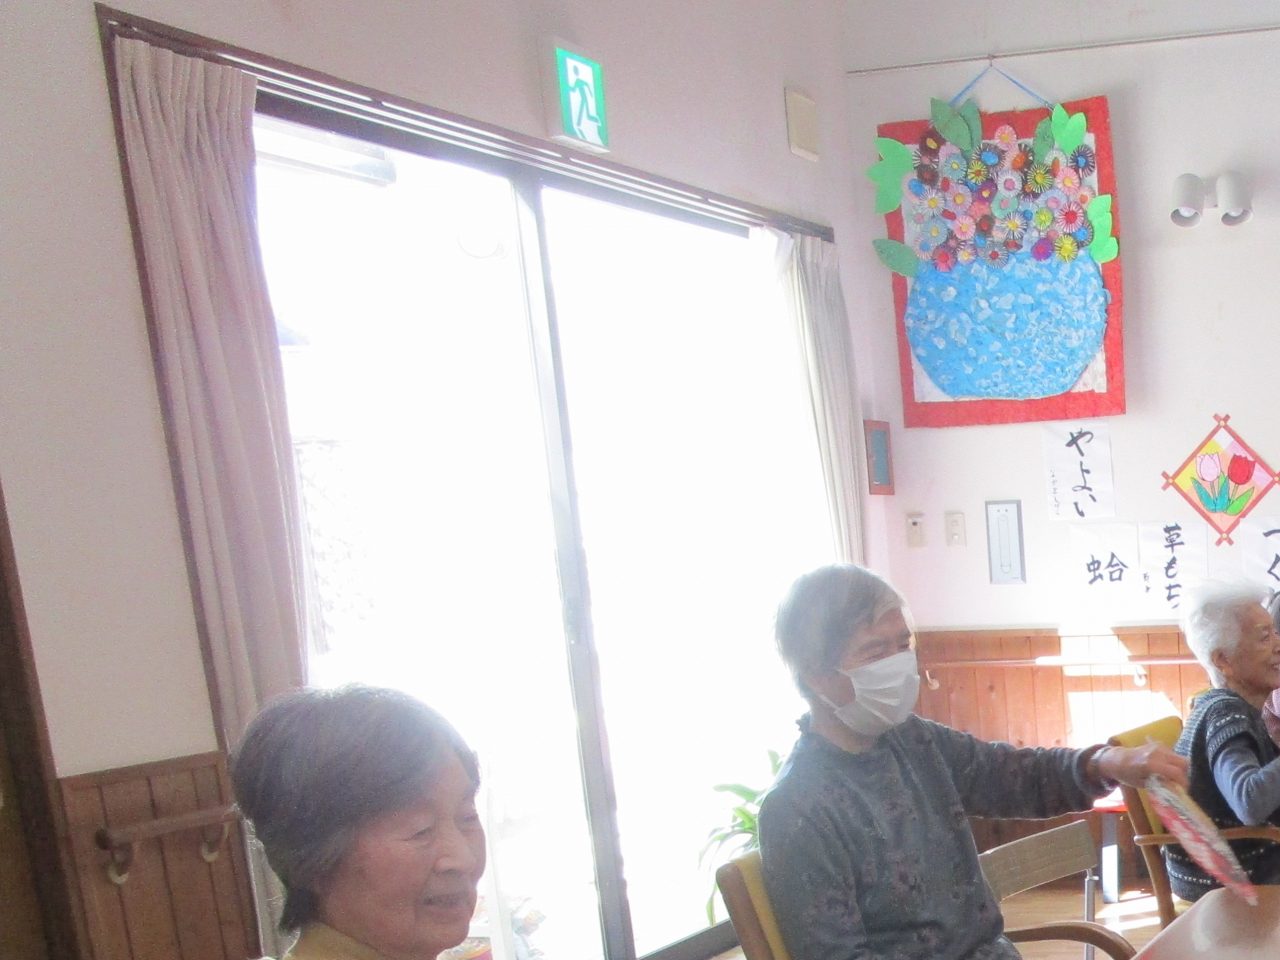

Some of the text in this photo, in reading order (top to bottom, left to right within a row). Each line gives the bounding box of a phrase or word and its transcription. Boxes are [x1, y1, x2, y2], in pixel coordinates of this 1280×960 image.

[1065, 427, 1097, 518] やよい
[1086, 551, 1129, 585] 蛤
[1162, 522, 1186, 609] 草もち
